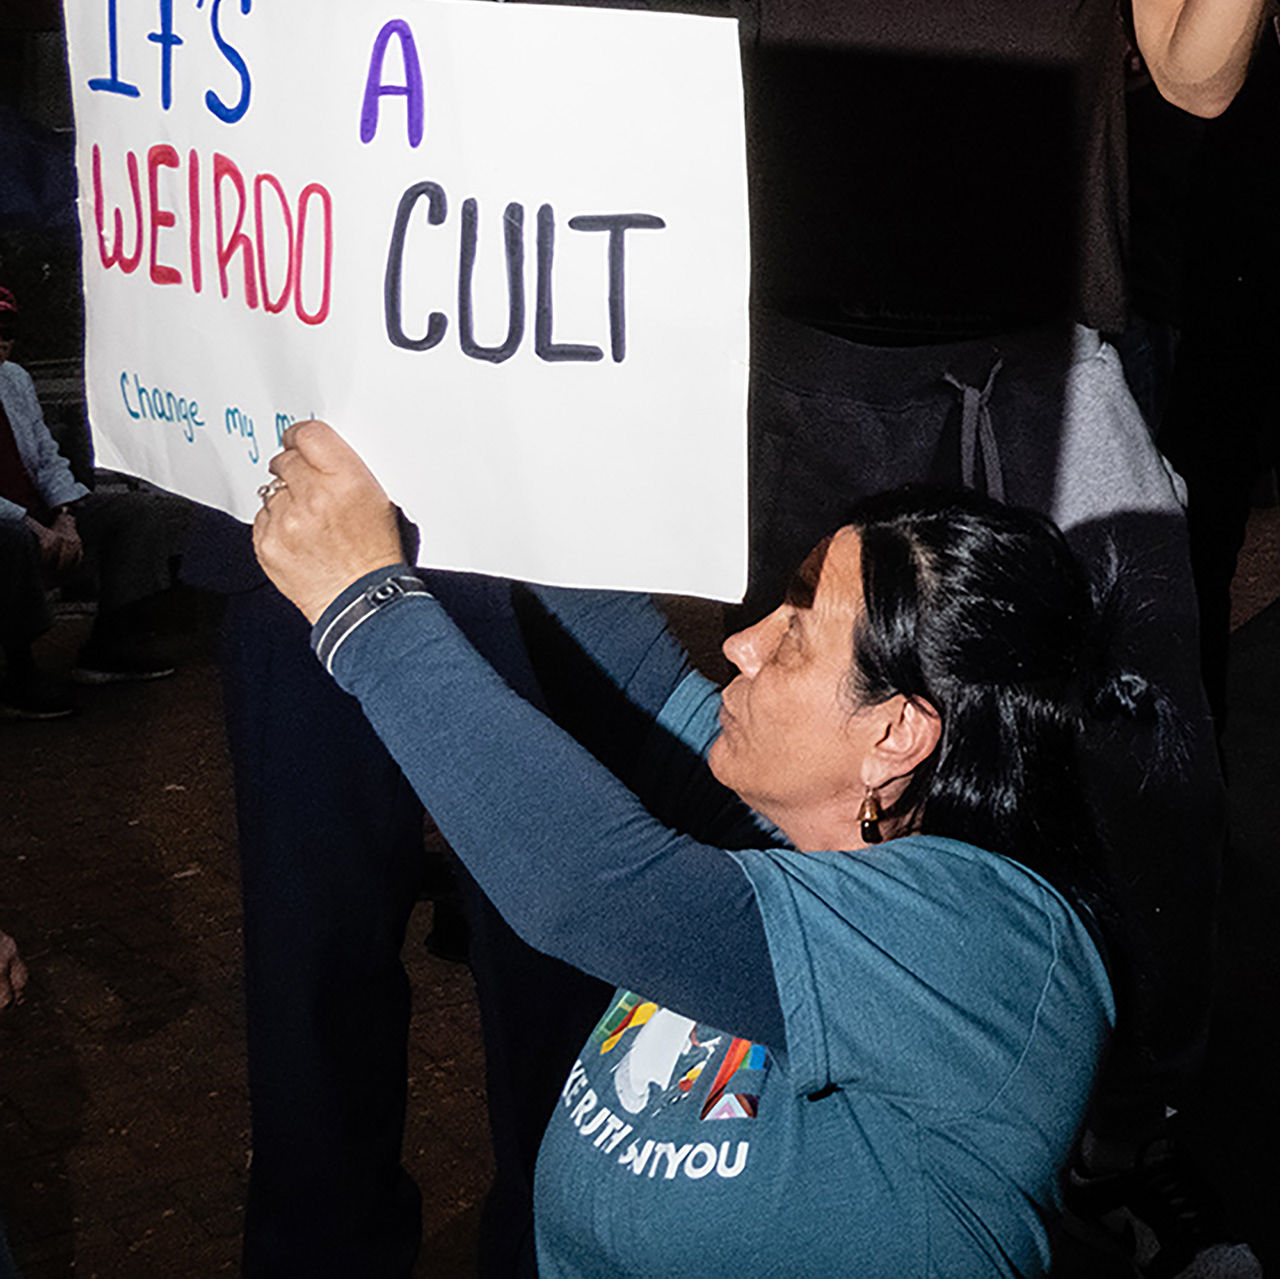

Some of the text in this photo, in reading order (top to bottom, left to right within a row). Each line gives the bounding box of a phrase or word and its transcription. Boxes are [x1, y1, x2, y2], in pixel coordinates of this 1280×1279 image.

[360, 19, 424, 148] A
[92, 143, 667, 364] WEIRDO CULT
[225, 407, 260, 464] my
[664, 1140, 749, 1180] YOU
